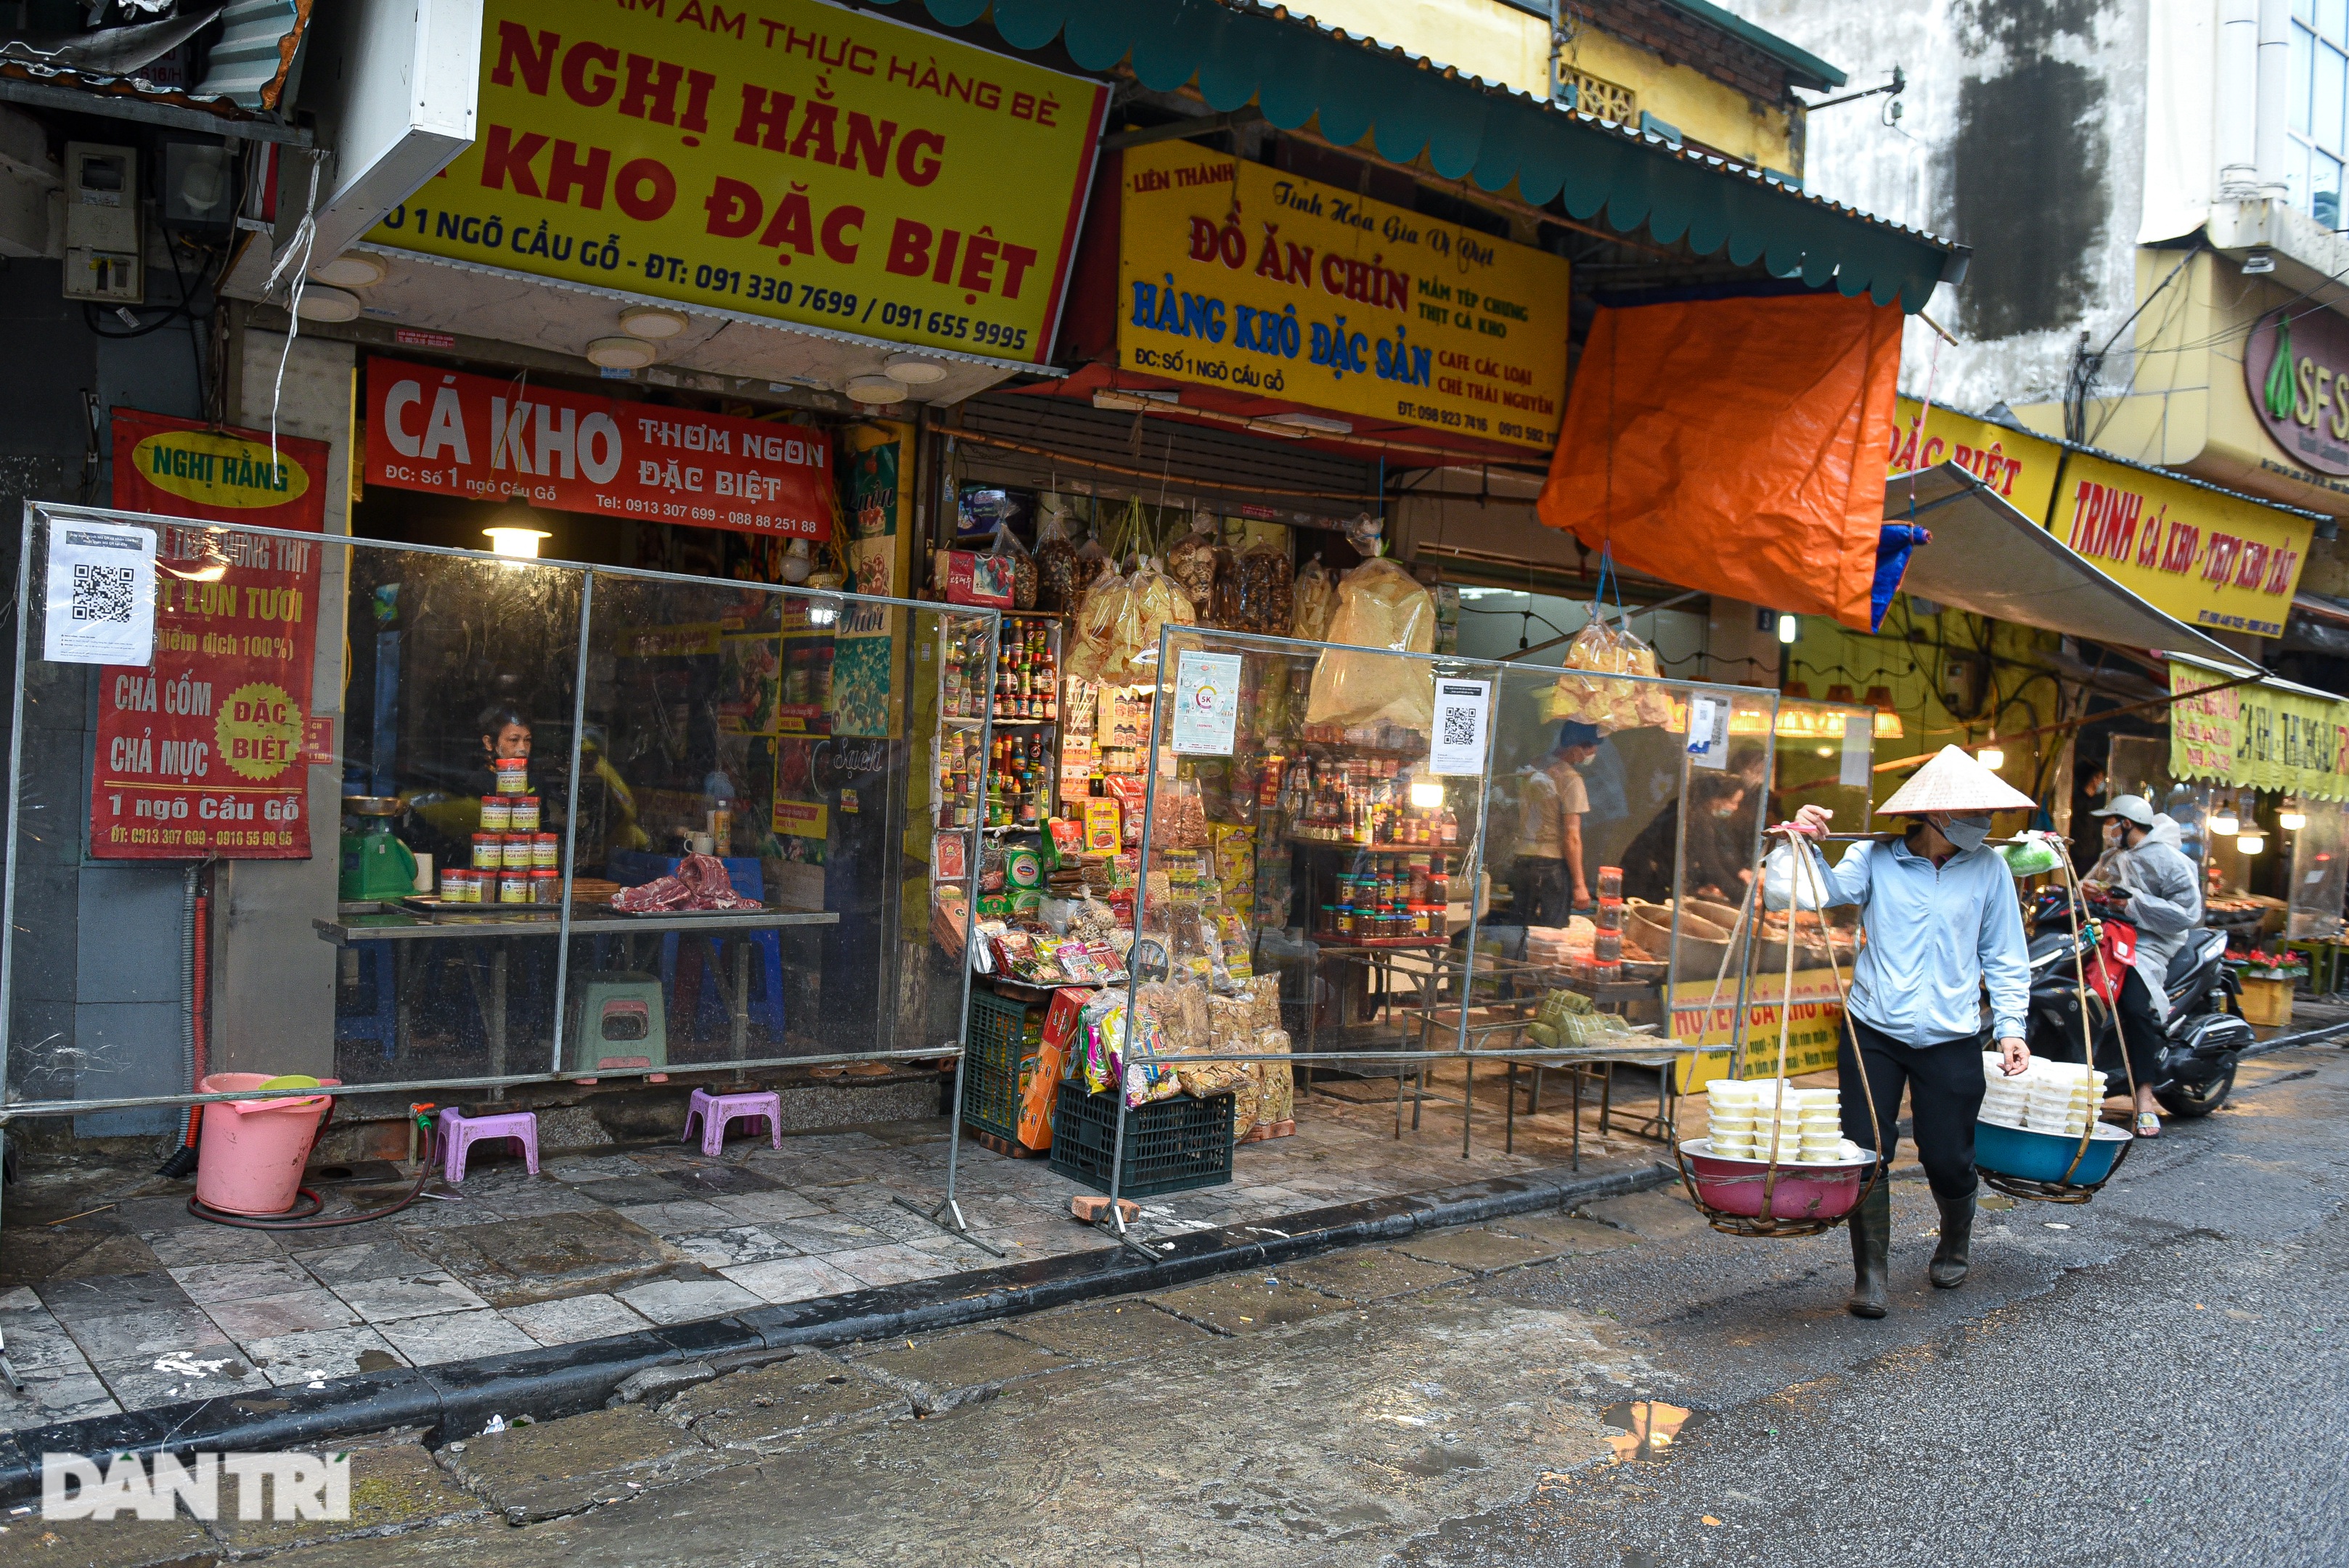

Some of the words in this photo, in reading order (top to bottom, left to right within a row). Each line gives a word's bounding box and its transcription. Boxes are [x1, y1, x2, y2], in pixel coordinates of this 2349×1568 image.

[759, 17, 878, 75] THỰC
[887, 56, 1002, 110] HÀNG
[1011, 91, 1060, 128] BÈ
[491, 20, 716, 147] NGHỊ
[734, 68, 946, 187] HẰNG
[1133, 169, 1169, 193] LIÊN
[1174, 163, 1234, 188] THÀNH
[480, 124, 677, 221] KHO
[704, 179, 865, 266] ĐẶC
[885, 218, 1038, 305] BIỆT
[1273, 181, 1322, 216] Tinh
[1330, 198, 1374, 231] Hoa
[1383, 216, 1418, 244] Gia
[1188, 199, 1247, 269] ĐỒ
[1254, 221, 1314, 289] ĂN
[1320, 252, 1410, 313] CHÍN
[414, 208, 428, 233] 1
[436, 211, 503, 248] NGÕ
[511, 219, 572, 261] CẦU
[579, 233, 621, 271] GỖ
[645, 253, 687, 284] ĐT:
[695, 265, 740, 295] 091
[745, 275, 793, 304] 330
[798, 285, 857, 316] 7699
[881, 303, 923, 331] 091
[927, 311, 969, 339] 655
[973, 320, 1027, 351] 9995
[1131, 273, 1226, 343] HÀNG
[1233, 303, 1300, 359] KHÔ
[1310, 314, 1368, 380] ĐẶC
[1376, 325, 1432, 388] SẢN
[1418, 302, 1448, 326] THỊT
[1479, 317, 1506, 338] KHO
[1186, 359, 1193, 373] 1
[1197, 360, 1227, 380] NGÕ
[1264, 369, 1284, 391] GỖ
[1438, 350, 1470, 371] CAFE
[1474, 357, 1498, 378] CÁC
[1504, 364, 1532, 387] LOẠI
[1398, 401, 1416, 417] ĐT:
[1467, 383, 1498, 404] THÁI
[1503, 390, 1553, 415] NGUYÊN
[384, 375, 471, 465] CÁ
[491, 396, 622, 484] KHO
[639, 418, 730, 454] THƠM
[743, 433, 824, 467] NGON
[153, 445, 214, 489] NGHỊ
[222, 448, 288, 492] HẰNG
[385, 465, 415, 481] ĐC:
[421, 468, 442, 485] Số
[448, 467, 457, 487] 1
[466, 478, 496, 494] ngõ
[534, 485, 556, 501] Gỗ
[638, 458, 703, 494] ĐẶC
[715, 470, 781, 504] BIỆT
[596, 494, 621, 509] Tel:
[626, 499, 658, 514] 0913
[663, 503, 687, 517] 307
[691, 507, 715, 521] 699
[729, 512, 751, 525] 088
[756, 515, 771, 528] 88
[775, 518, 796, 531] 251
[801, 520, 816, 533] 88
[276, 537, 311, 580] THỊT
[2136, 503, 2168, 568] CÁ
[2160, 520, 2200, 574] KHO
[2202, 531, 2242, 592] THỊT
[184, 581, 237, 622] LỢN
[245, 587, 303, 623] TƯƠI
[203, 632, 237, 659] dịch
[243, 635, 294, 661] 100%)
[115, 666, 157, 713] CHẢ
[165, 669, 212, 716] CỐM
[234, 698, 287, 728] ĐẶC
[110, 727, 152, 774] CHẢ
[160, 739, 209, 783] MỰC
[232, 735, 290, 764] BIỆT
[833, 738, 883, 779] Sạch
[109, 794, 122, 816] 1
[135, 796, 188, 819] ngõ
[199, 794, 253, 820] Cầu
[264, 796, 299, 820] Gỗ
[246, 831, 260, 846] 55
[262, 831, 276, 846] 99
